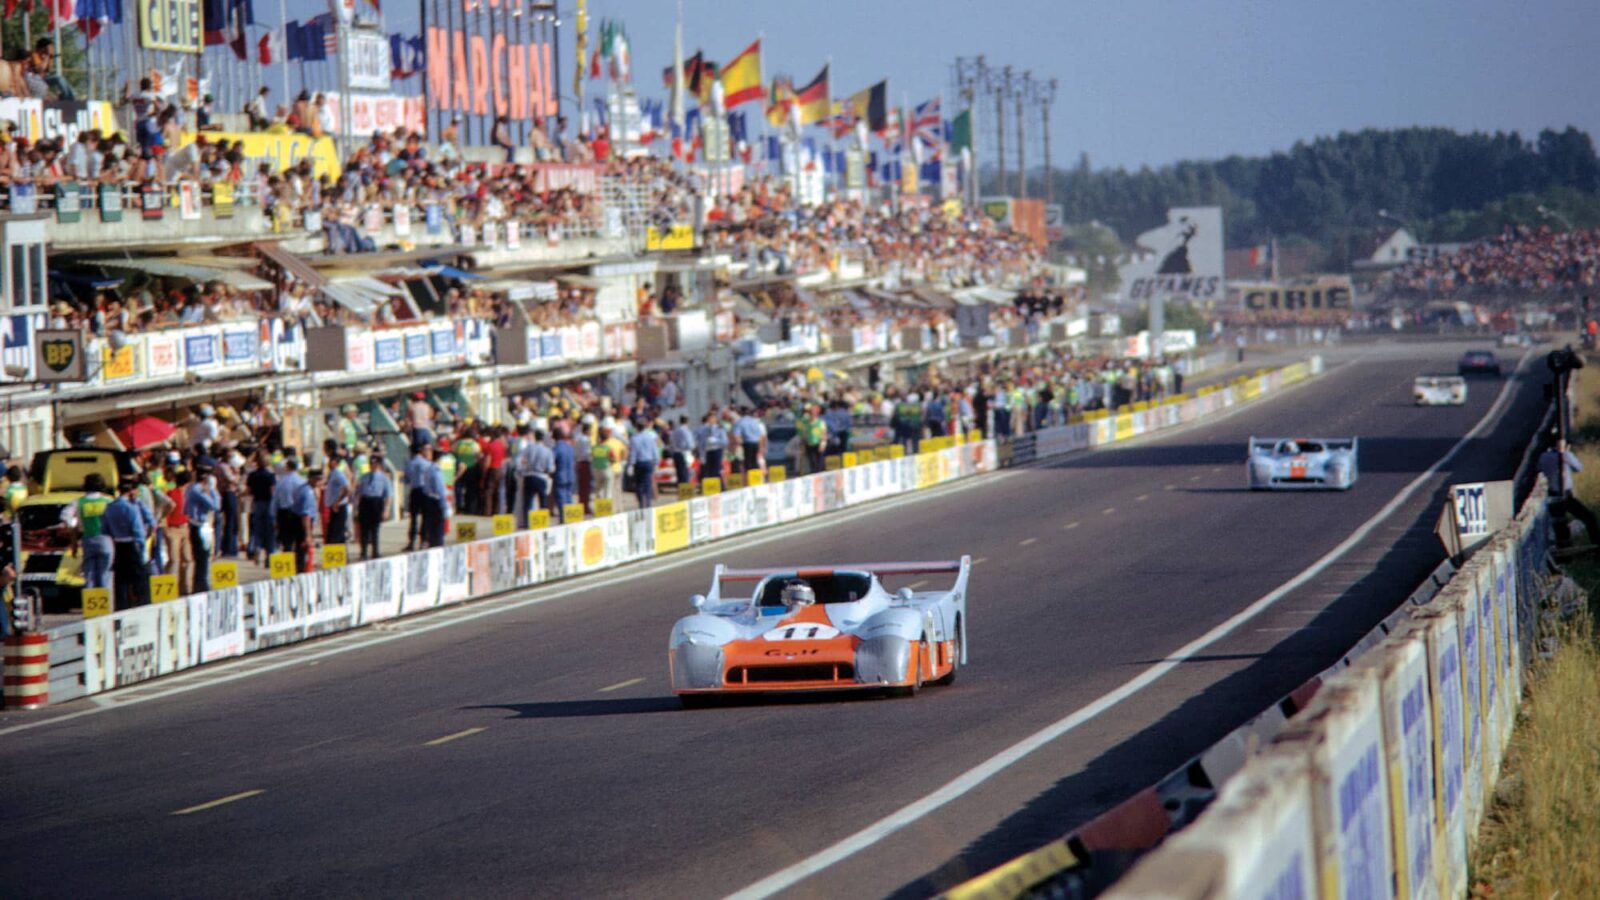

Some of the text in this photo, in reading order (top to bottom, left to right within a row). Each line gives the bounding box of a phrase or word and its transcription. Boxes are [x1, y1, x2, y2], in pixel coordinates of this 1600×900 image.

[427, 26, 558, 120] MARCHAL
[46, 343, 73, 365] BP
[325, 551, 344, 562] 93
[274, 560, 291, 573] 91
[215, 569, 236, 582] 90
[153, 583, 175, 594] 77
[86, 596, 110, 611] 52
[781, 627, 819, 638] 11
[764, 648, 819, 657] Gulf
